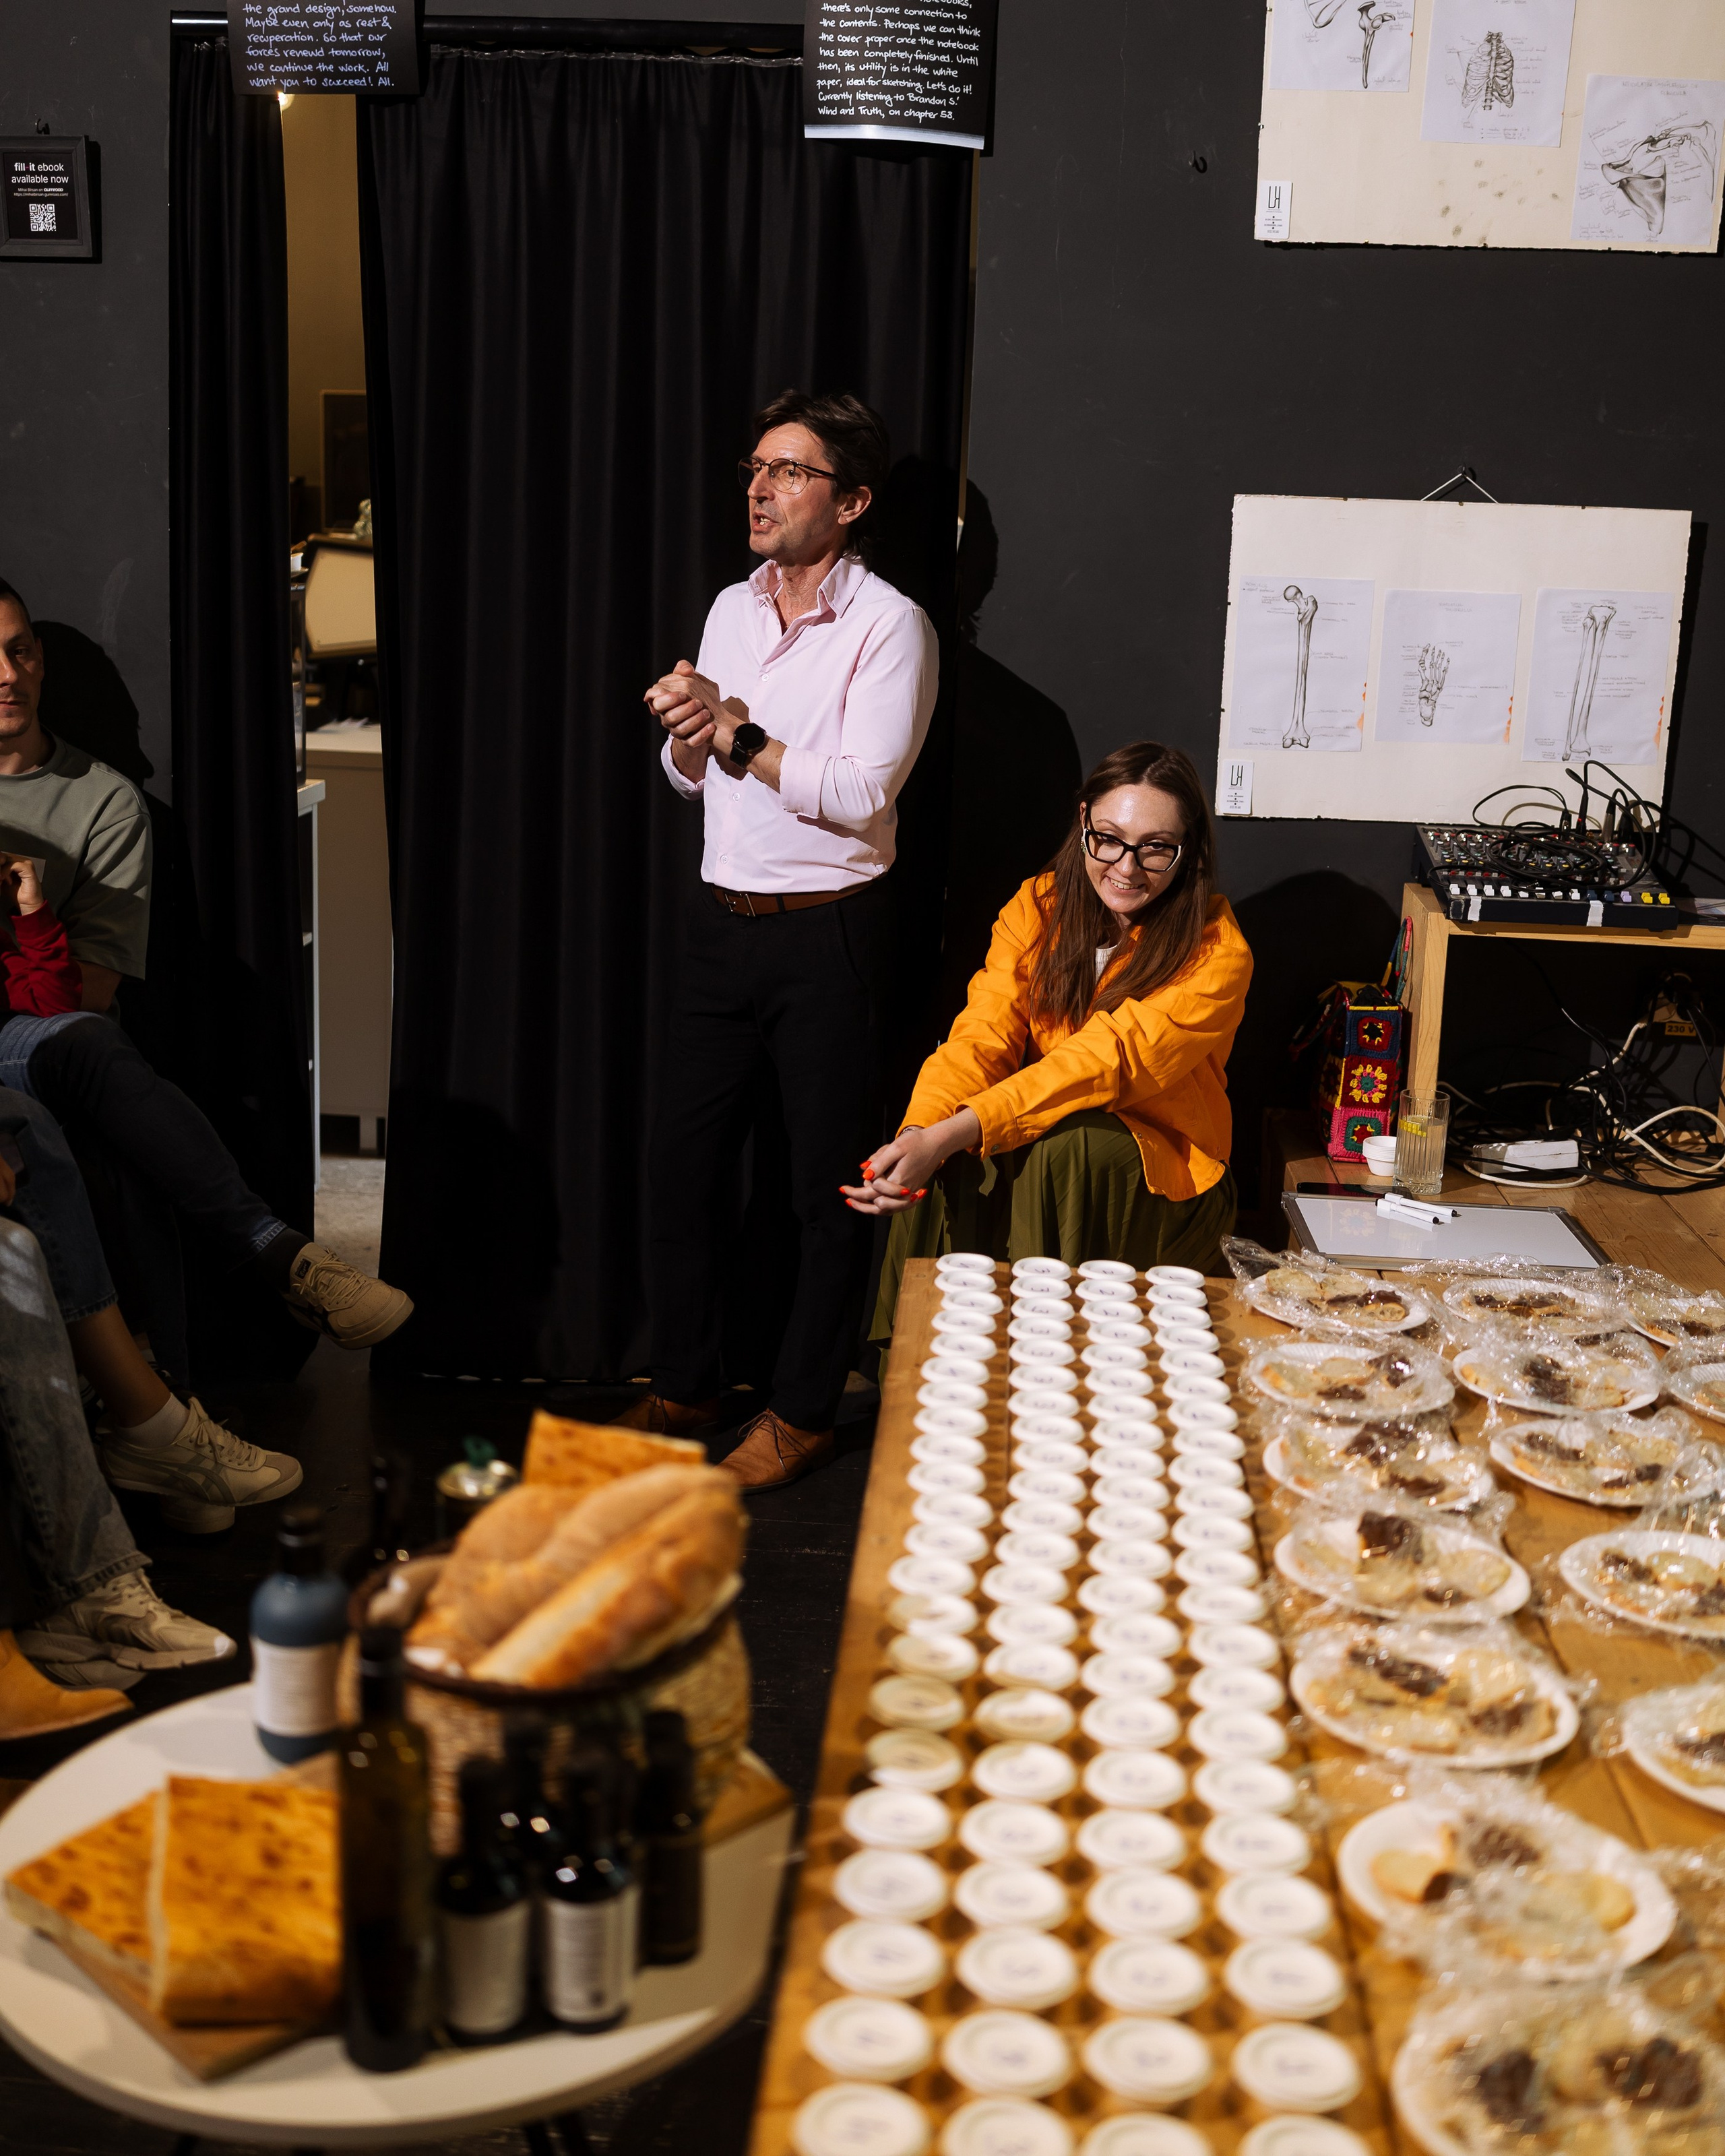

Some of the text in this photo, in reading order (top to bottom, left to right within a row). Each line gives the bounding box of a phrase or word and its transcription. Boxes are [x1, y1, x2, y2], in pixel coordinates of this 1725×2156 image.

[243, 3, 262, 13] the
[267, 4, 300, 19] grand
[306, 5, 345, 19] design,
[821, 3, 851, 12] there's
[854, 5, 873, 20] only
[875, 5, 900, 14] some
[904, 9, 953, 19] connection
[245, 17, 280, 34] Maybe
[282, 20, 309, 28] even
[313, 18, 334, 34] only
[356, 18, 381, 27] rest
[381, 16, 391, 30] &
[819, 18, 836, 27] the
[884, 19, 920, 35] Perhaps
[939, 26, 955, 34] can
[956, 26, 980, 36] think
[323, 31, 337, 42] So
[339, 32, 363, 41] that
[819, 32, 834, 42] the
[837, 34, 862, 42] cover
[865, 36, 895, 47] proper
[918, 36, 934, 45] the
[937, 40, 979, 51] notebook
[245, 46, 280, 57] forces
[328, 48, 385, 59] tomorrow,
[819, 47, 978, 66] has been completely finished. Until
[247, 62, 389, 72] we continue the work. All
[817, 63, 958, 78] then, its utility is in the white
[249, 77, 394, 92] want you to succeed! All.
[817, 77, 972, 94] paper, ideal for sketching. Let's do it!
[818, 92, 852, 106] Currently
[856, 90, 893, 106] listening
[893, 93, 904, 101] to
[907, 93, 945, 106] Brandon
[817, 107, 837, 115] Wind
[840, 107, 854, 115] and
[858, 106, 885, 118] Truth,
[904, 109, 938, 123] chapter
[940, 110, 955, 120] 58.
[38, 163, 64, 171] ebook
[11, 175, 48, 183] available
